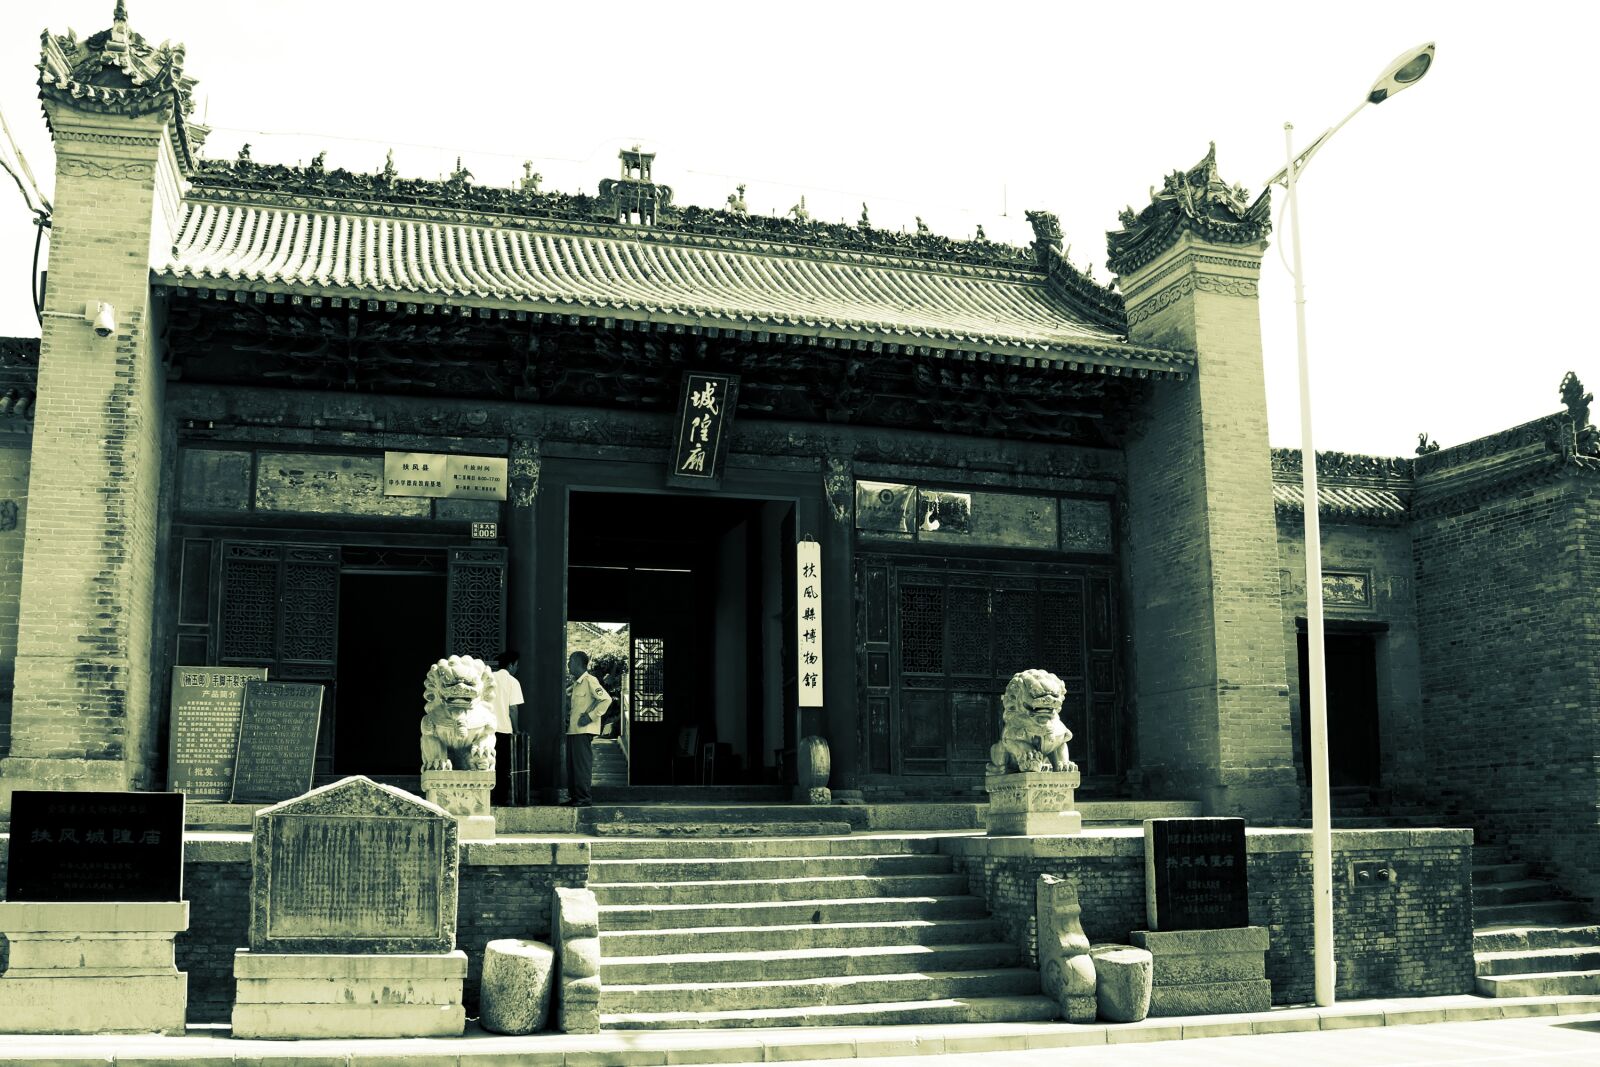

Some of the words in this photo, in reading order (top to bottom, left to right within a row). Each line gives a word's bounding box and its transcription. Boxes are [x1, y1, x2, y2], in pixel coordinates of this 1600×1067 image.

[479, 529, 495, 538] 005
[30, 827, 162, 845] 扶风城隍庙
